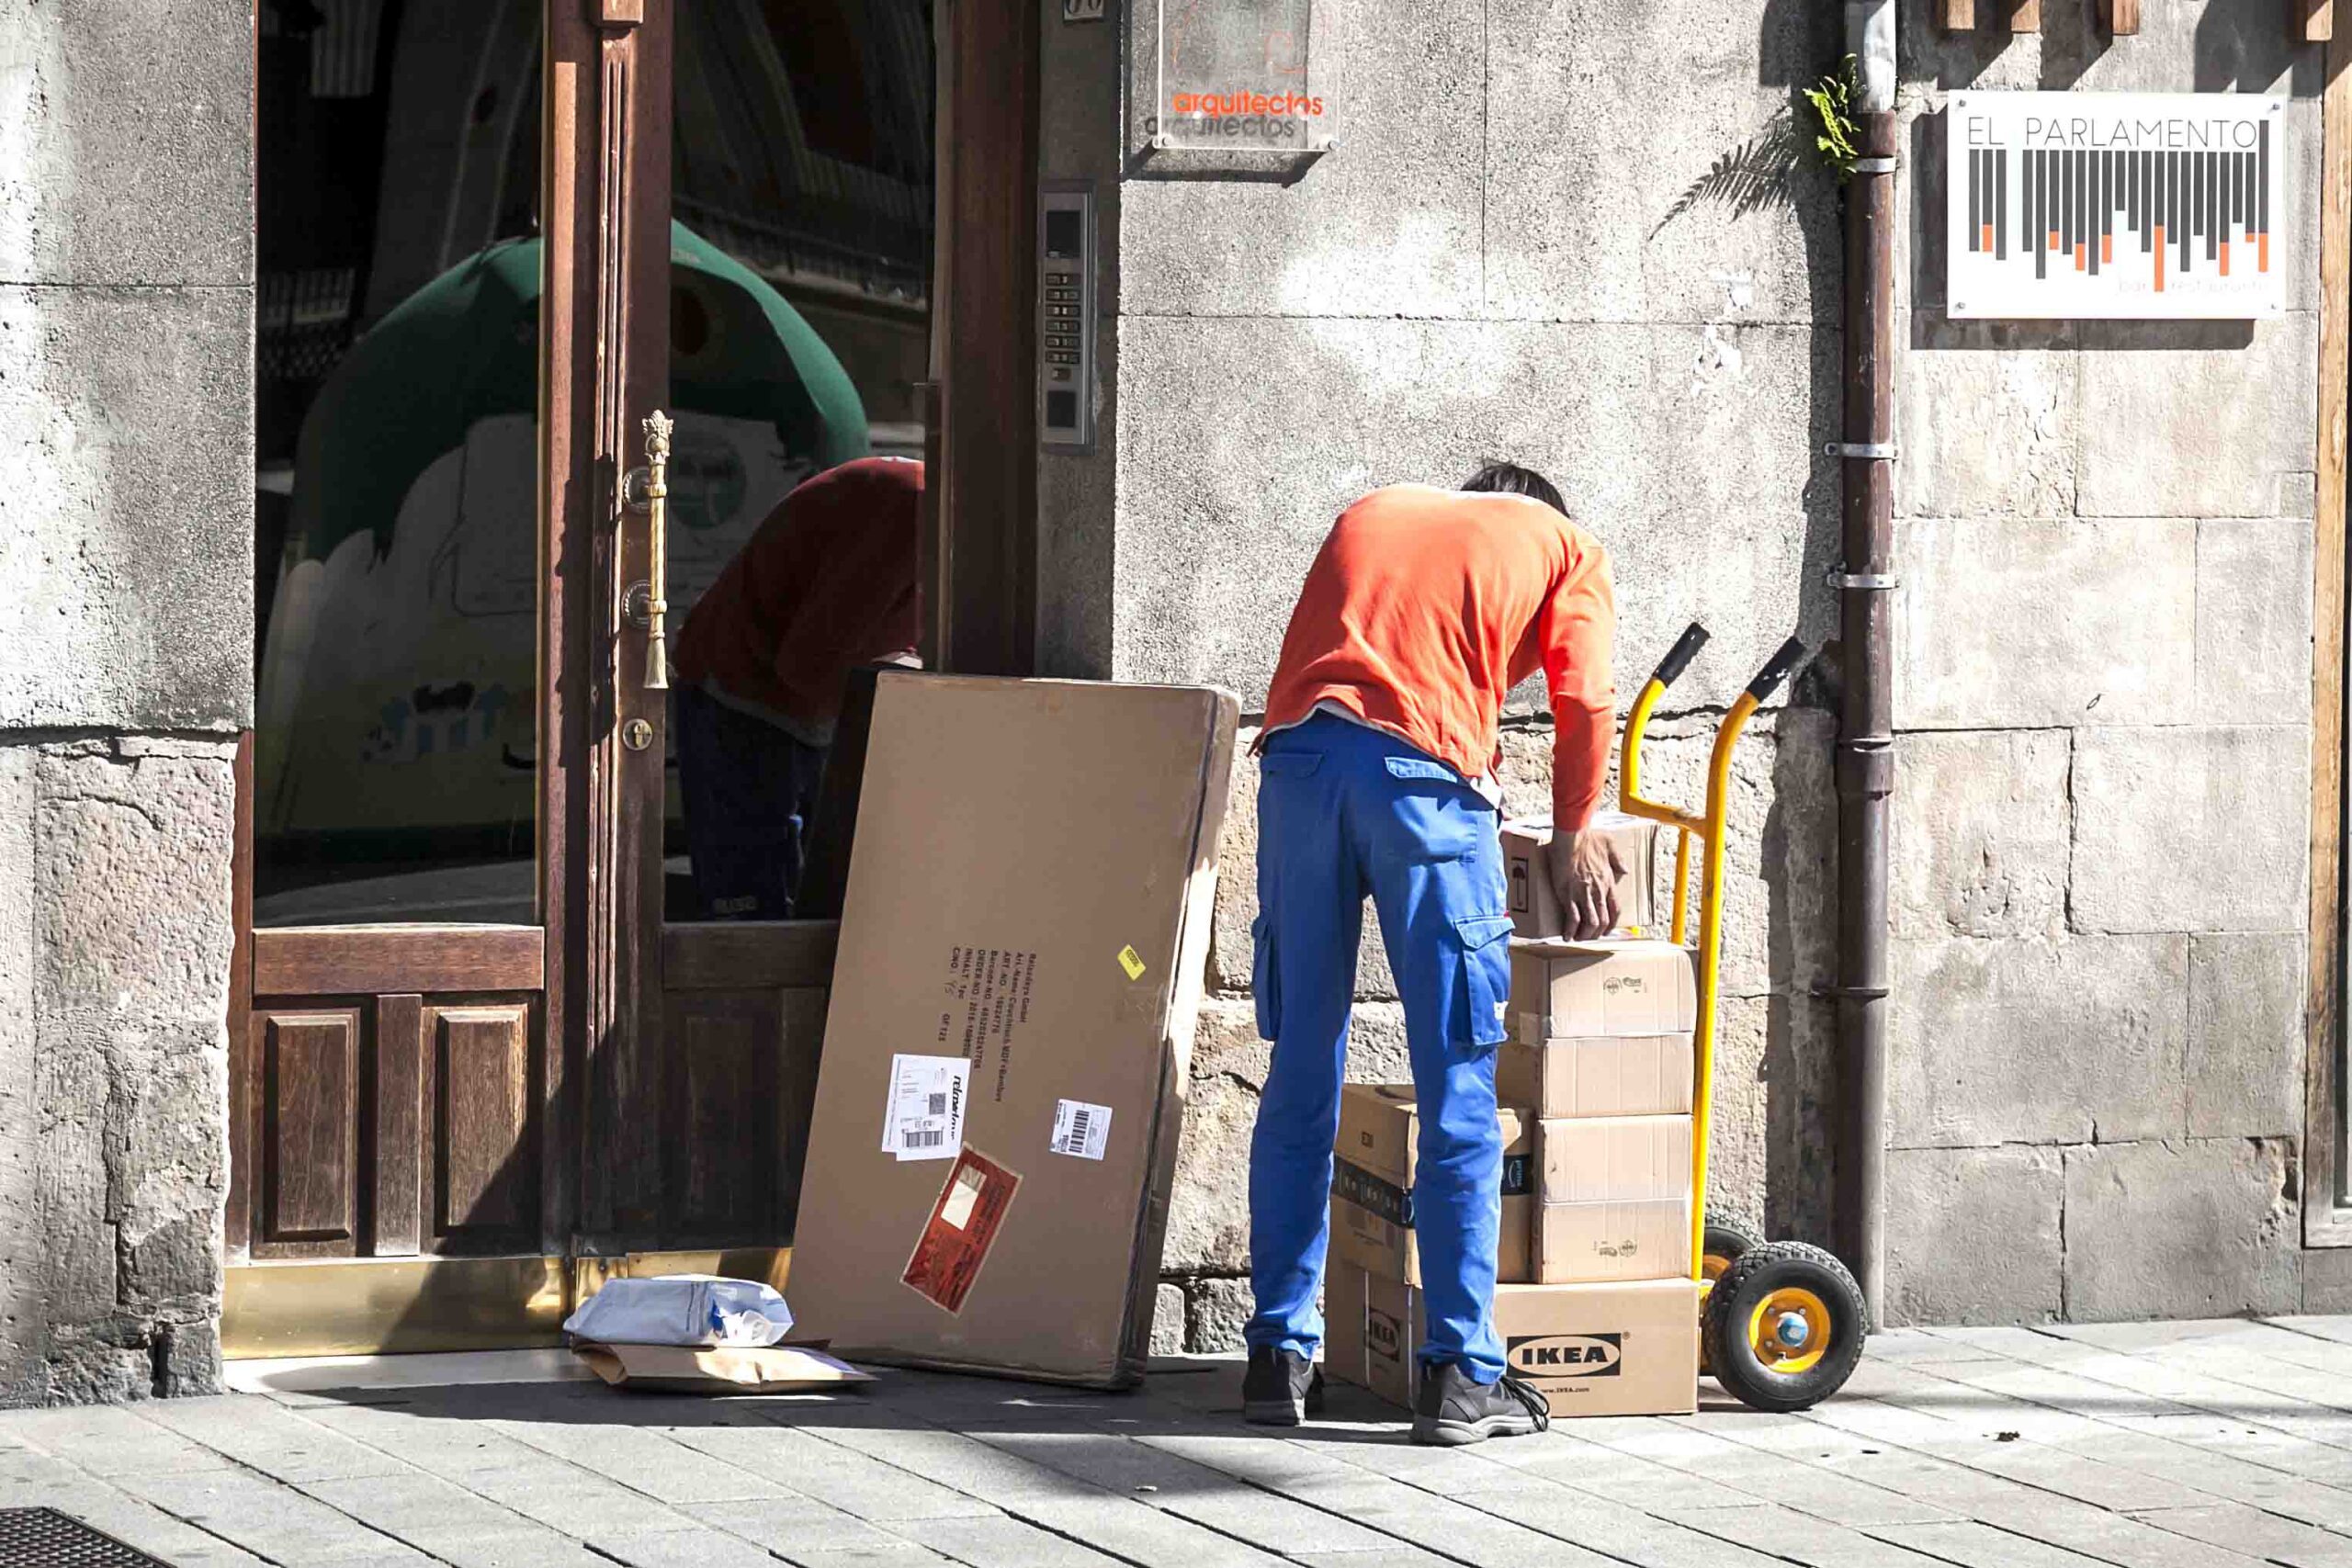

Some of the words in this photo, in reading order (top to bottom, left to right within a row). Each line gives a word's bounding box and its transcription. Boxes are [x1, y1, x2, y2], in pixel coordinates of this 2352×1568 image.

[1173, 91, 1323, 118] arquitectos
[1968, 117, 2005, 145] EL
[2026, 118, 2257, 148] PARLAMENTO
[1521, 1346, 1609, 1365] IKEA
